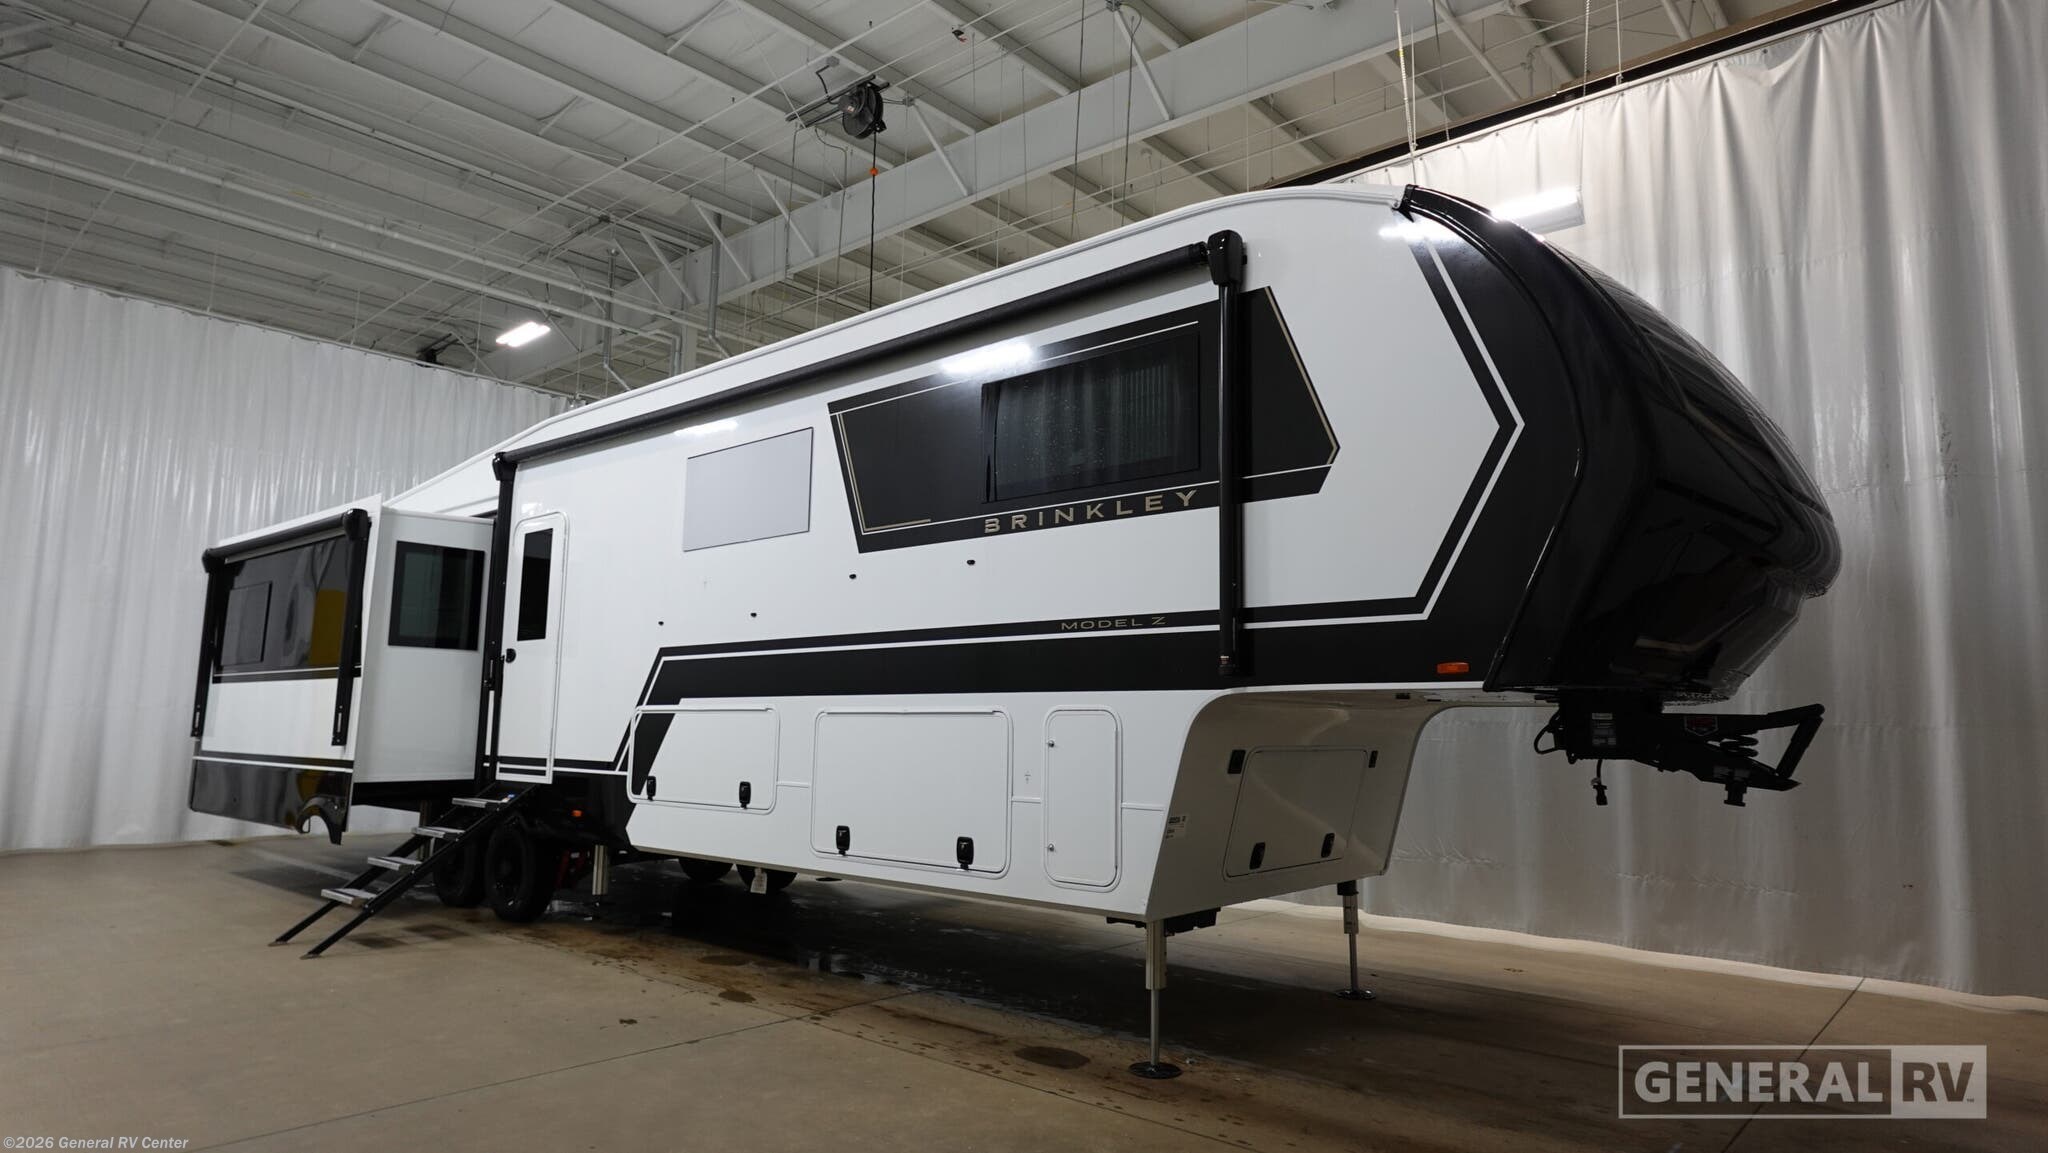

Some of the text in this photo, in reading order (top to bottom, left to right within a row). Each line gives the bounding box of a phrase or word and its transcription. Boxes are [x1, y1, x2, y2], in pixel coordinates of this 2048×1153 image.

[984, 489, 1197, 534] BRINKLEY
[1061, 616, 1167, 631] MODEL Z
